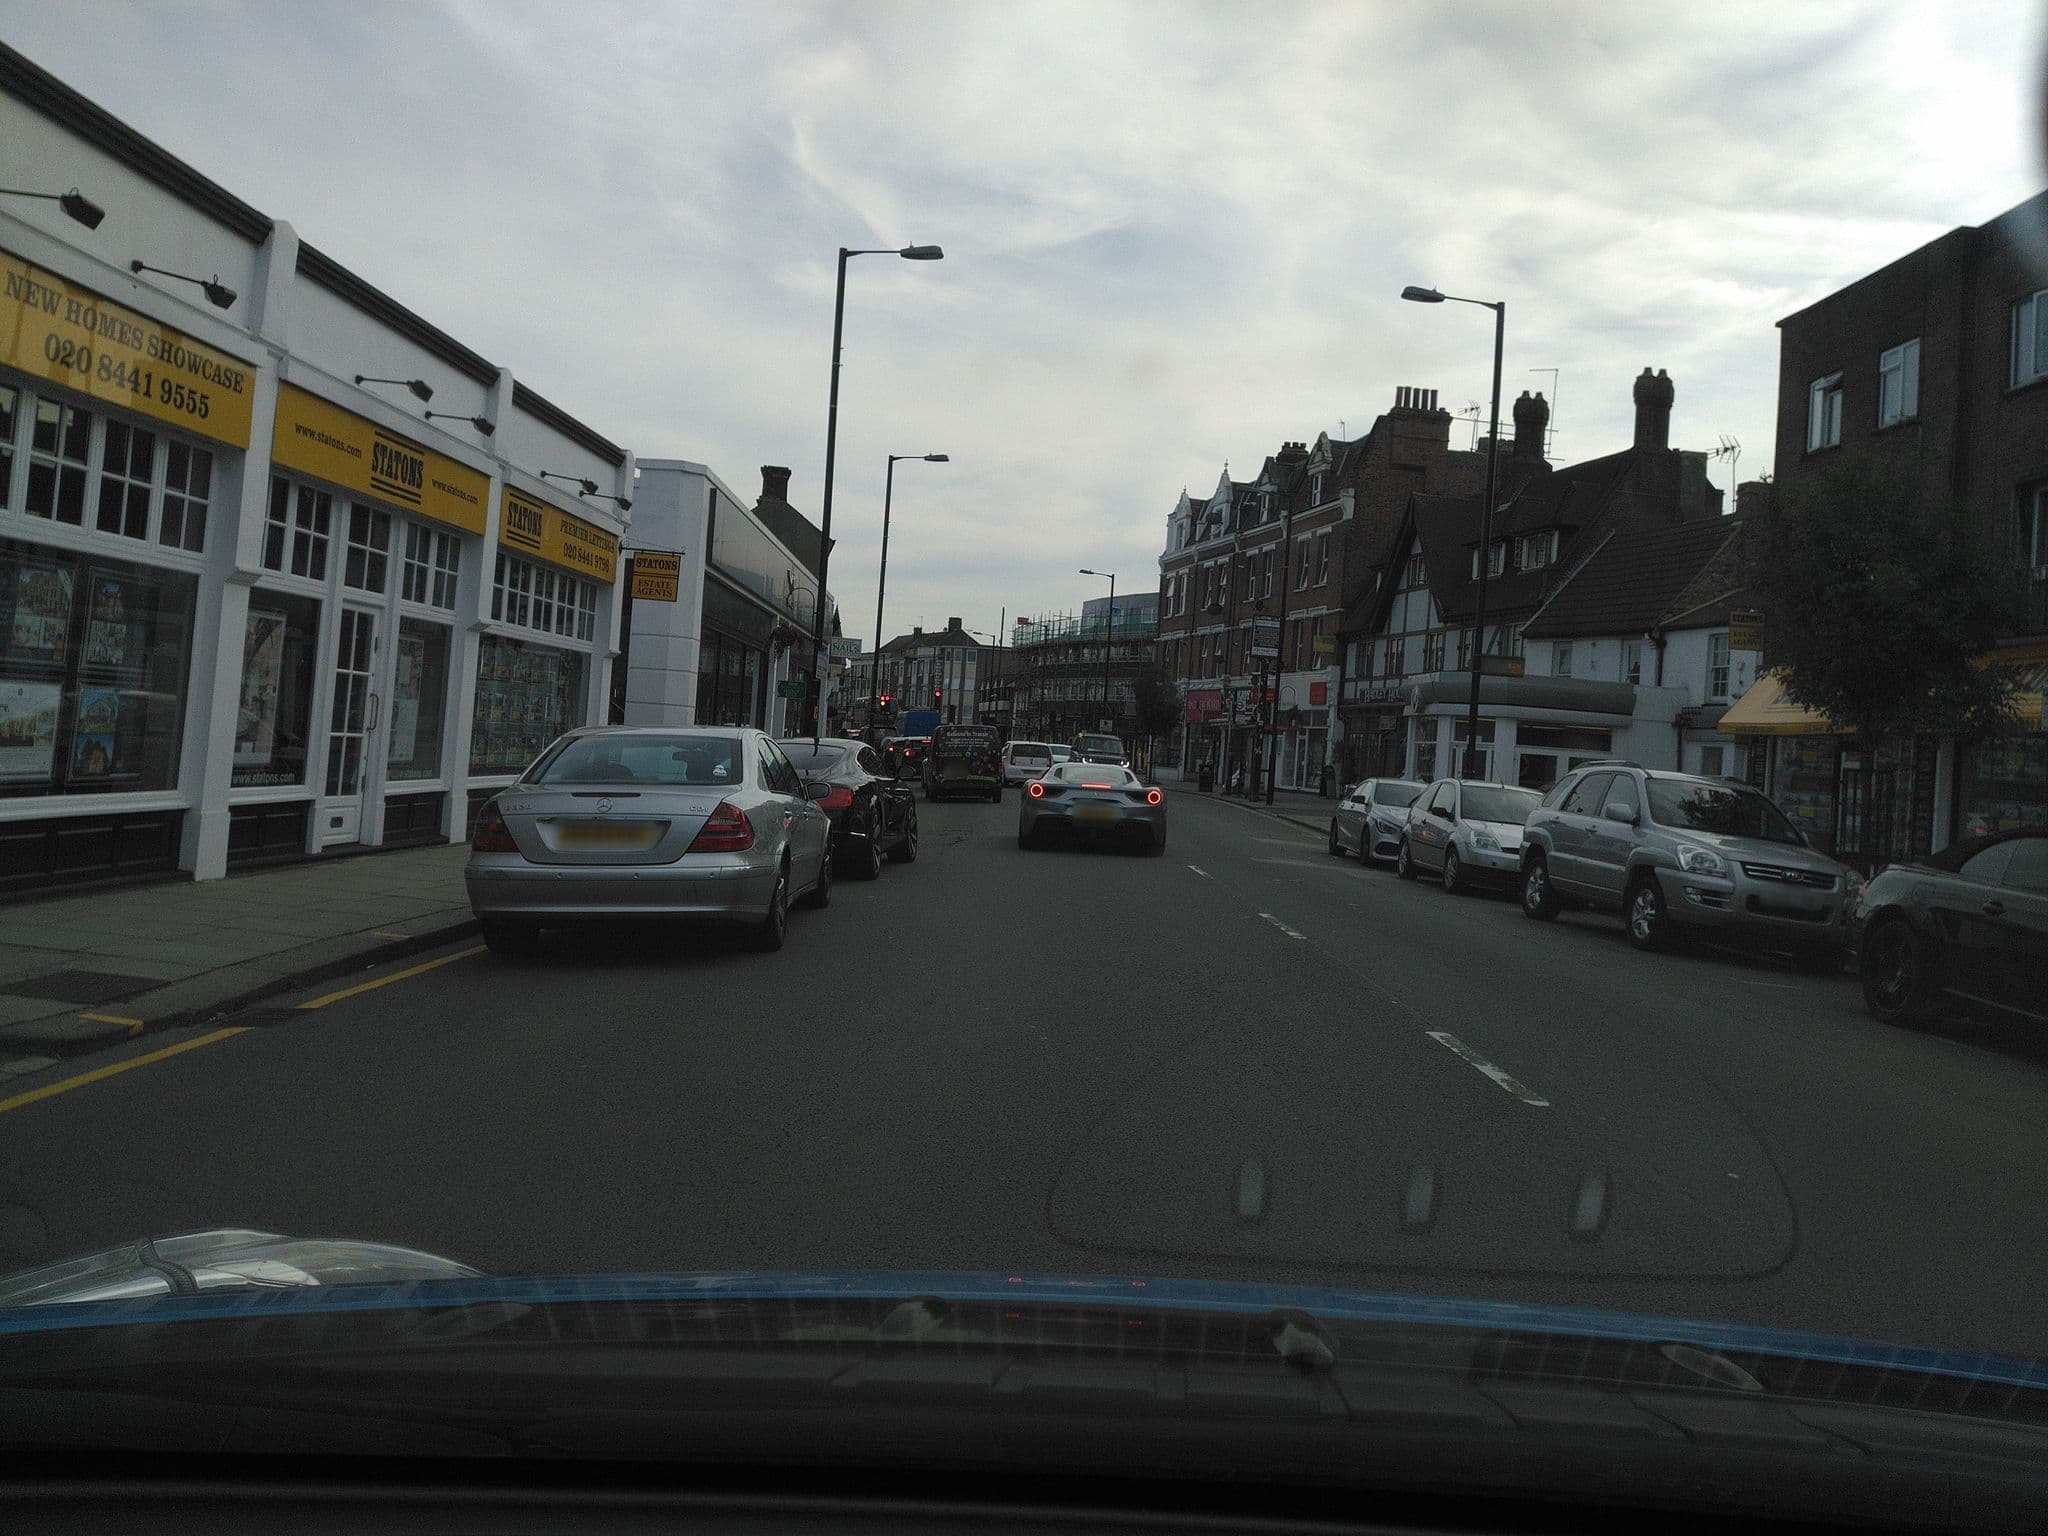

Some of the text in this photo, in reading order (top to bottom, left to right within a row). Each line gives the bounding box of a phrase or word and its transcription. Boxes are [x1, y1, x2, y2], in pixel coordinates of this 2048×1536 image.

[4, 271, 244, 394] NEW HOMES SHOWCASE
[44, 333, 210, 418] 020 8441 9555
[295, 423, 362, 459] www.statons.com
[371, 441, 424, 489] STATONS
[432, 478, 479, 505] www.statons.com
[507, 501, 543, 537] STATONS
[560, 520, 588, 544] PREMIER
[563, 542, 576, 561] 020
[635, 557, 678, 572] STATONS
[636, 587, 673, 598] AGENTS
[638, 579, 673, 590] ESTATE
[232, 771, 294, 785] www.statons.com
